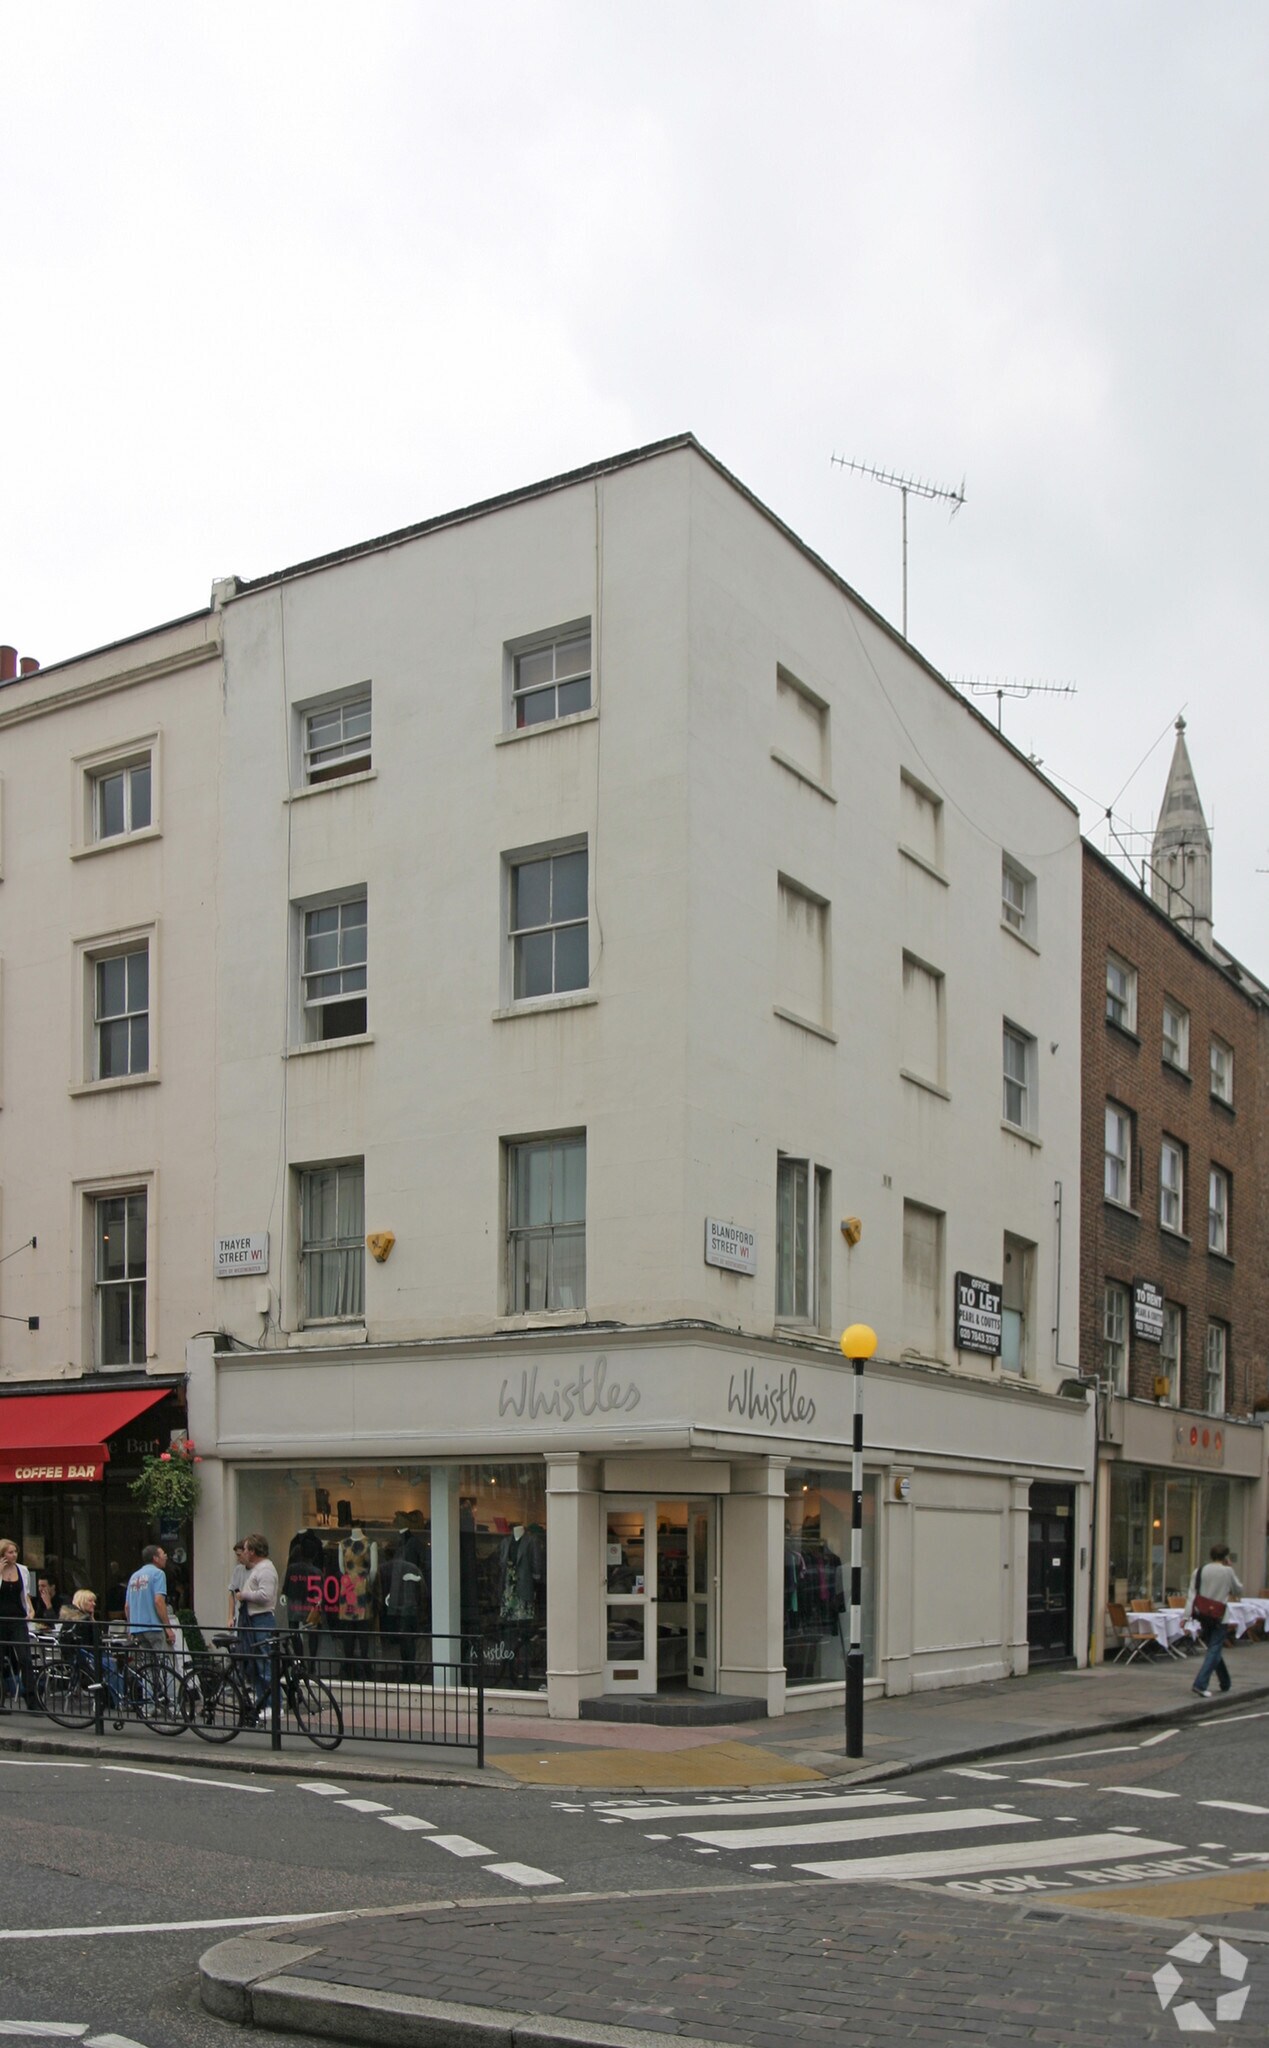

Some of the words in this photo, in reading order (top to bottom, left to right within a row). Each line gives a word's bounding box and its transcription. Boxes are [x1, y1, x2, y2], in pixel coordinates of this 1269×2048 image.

[220, 1237, 251, 1251] THAYER
[711, 1223, 754, 1246] BLANDFORD
[219, 1250, 248, 1264] STREET
[250, 1249, 263, 1261] W1
[711, 1237, 738, 1255] STREET
[739, 1244, 750, 1259] W1
[971, 1279, 990, 1292] OFFICE
[960, 1286, 976, 1306] TO
[979, 1291, 1000, 1313] LET
[1136, 1289, 1146, 1302] TO
[1146, 1292, 1162, 1309] RENT
[959, 1309, 975, 1324] PEARL
[975, 1314, 980, 1325] &
[981, 1315, 1001, 1330] COUTTS
[960, 1327, 971, 1339] 020
[499, 1353, 641, 1422] Whistles
[727, 1366, 816, 1426] Whistles
[127, 1438, 155, 1453] Bar
[15, 1465, 63, 1479] COFFEE
[67, 1465, 96, 1478] BAR
[306, 1573, 358, 1605] 50%
[945, 1874, 1074, 1894] OOK
[1065, 1855, 1231, 1884] RIGHT
